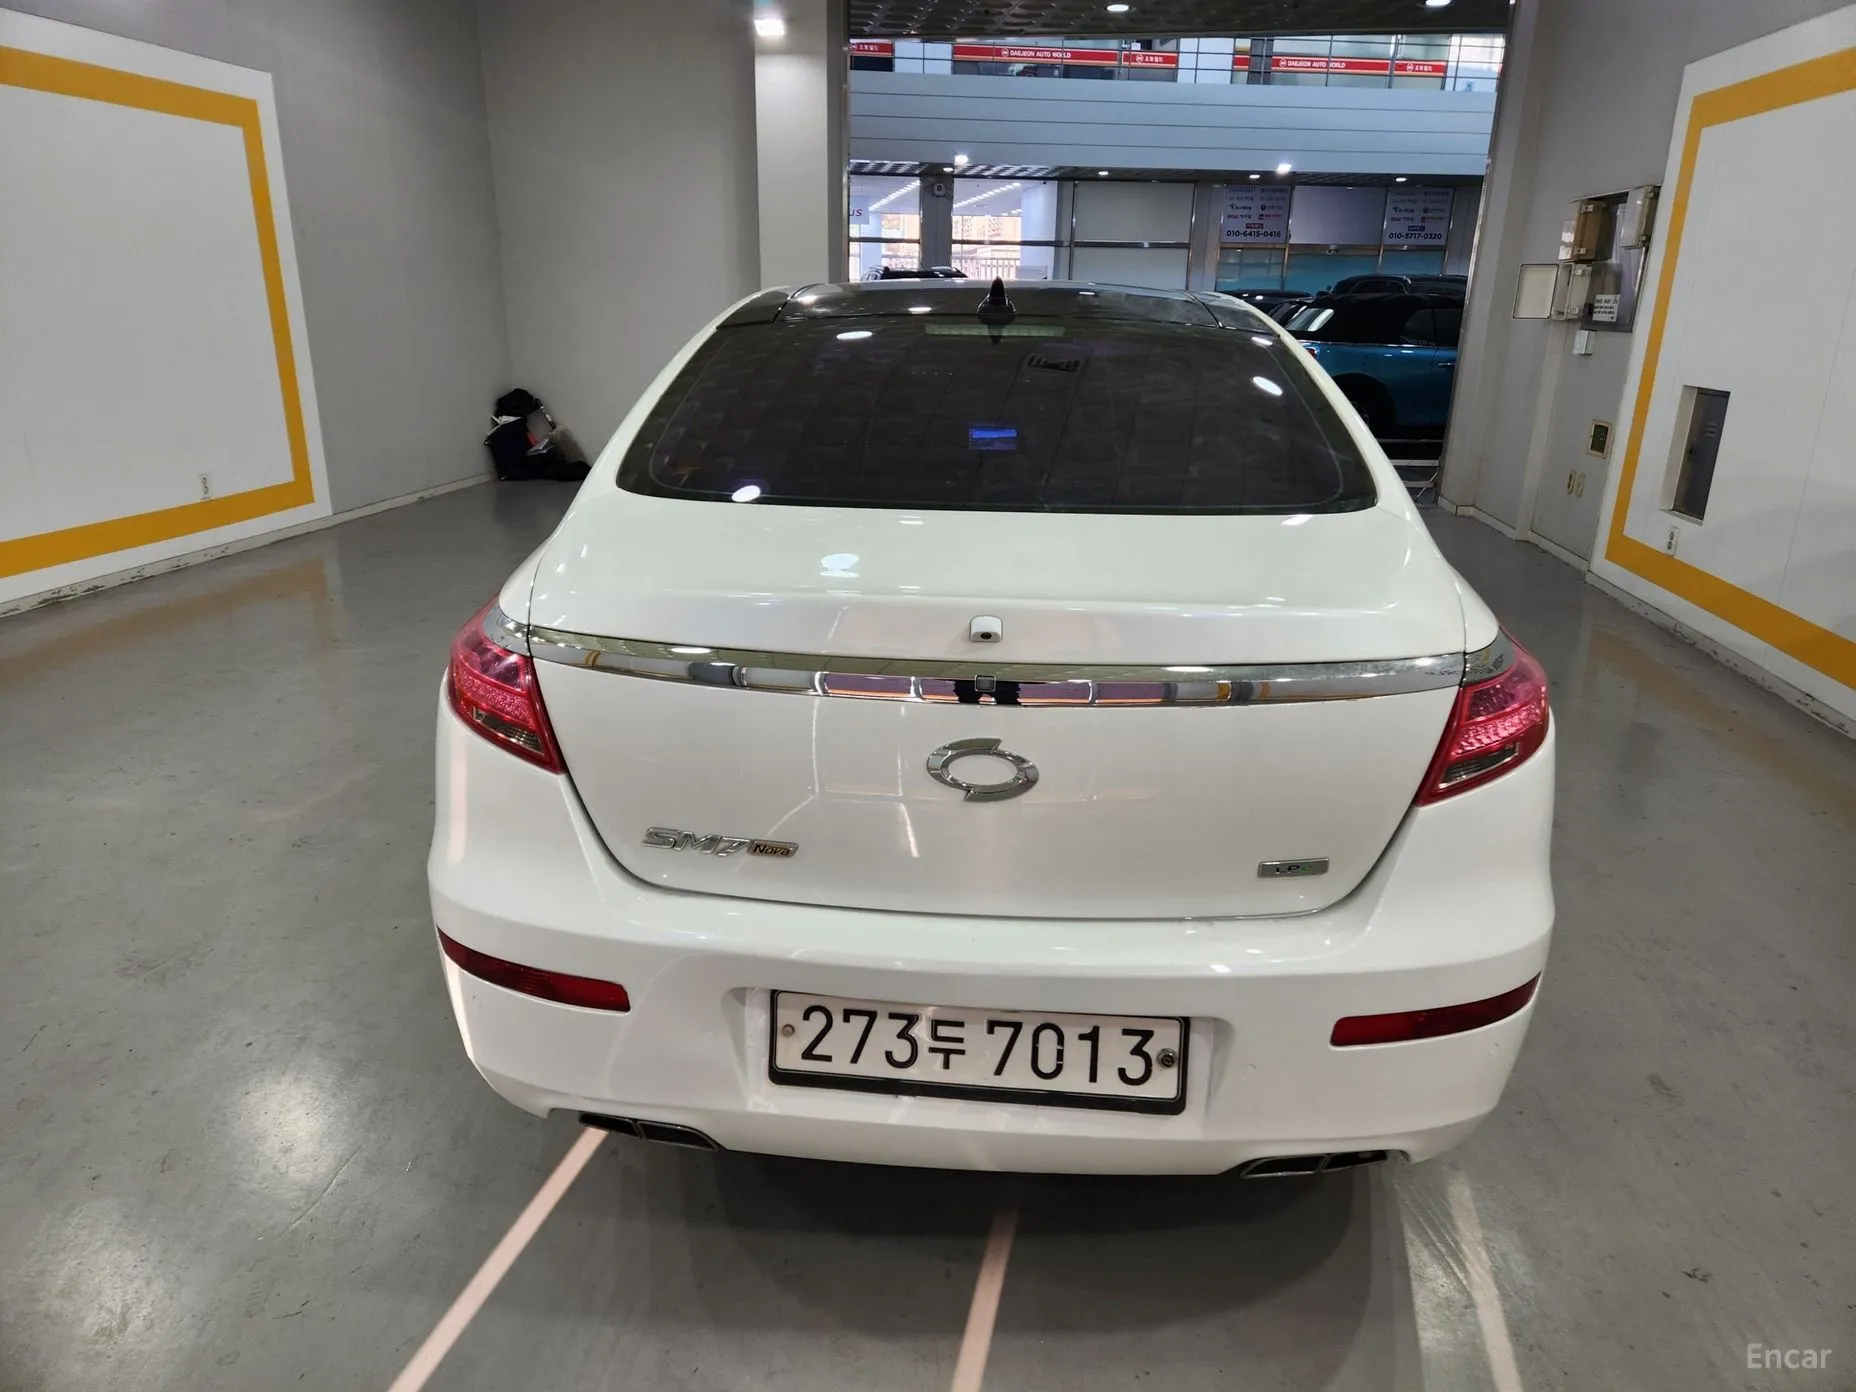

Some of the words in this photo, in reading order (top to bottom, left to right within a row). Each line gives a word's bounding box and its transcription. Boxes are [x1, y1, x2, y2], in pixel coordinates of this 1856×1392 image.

[1010, 49, 1035, 57] DAEJEON
[1036, 50, 1051, 58] AUTO
[1287, 60, 1311, 68] DAEJEON
[1226, 230, 1282, 238] 010-6415-0416
[641, 826, 750, 857] SM7
[752, 843, 791, 856] Nova
